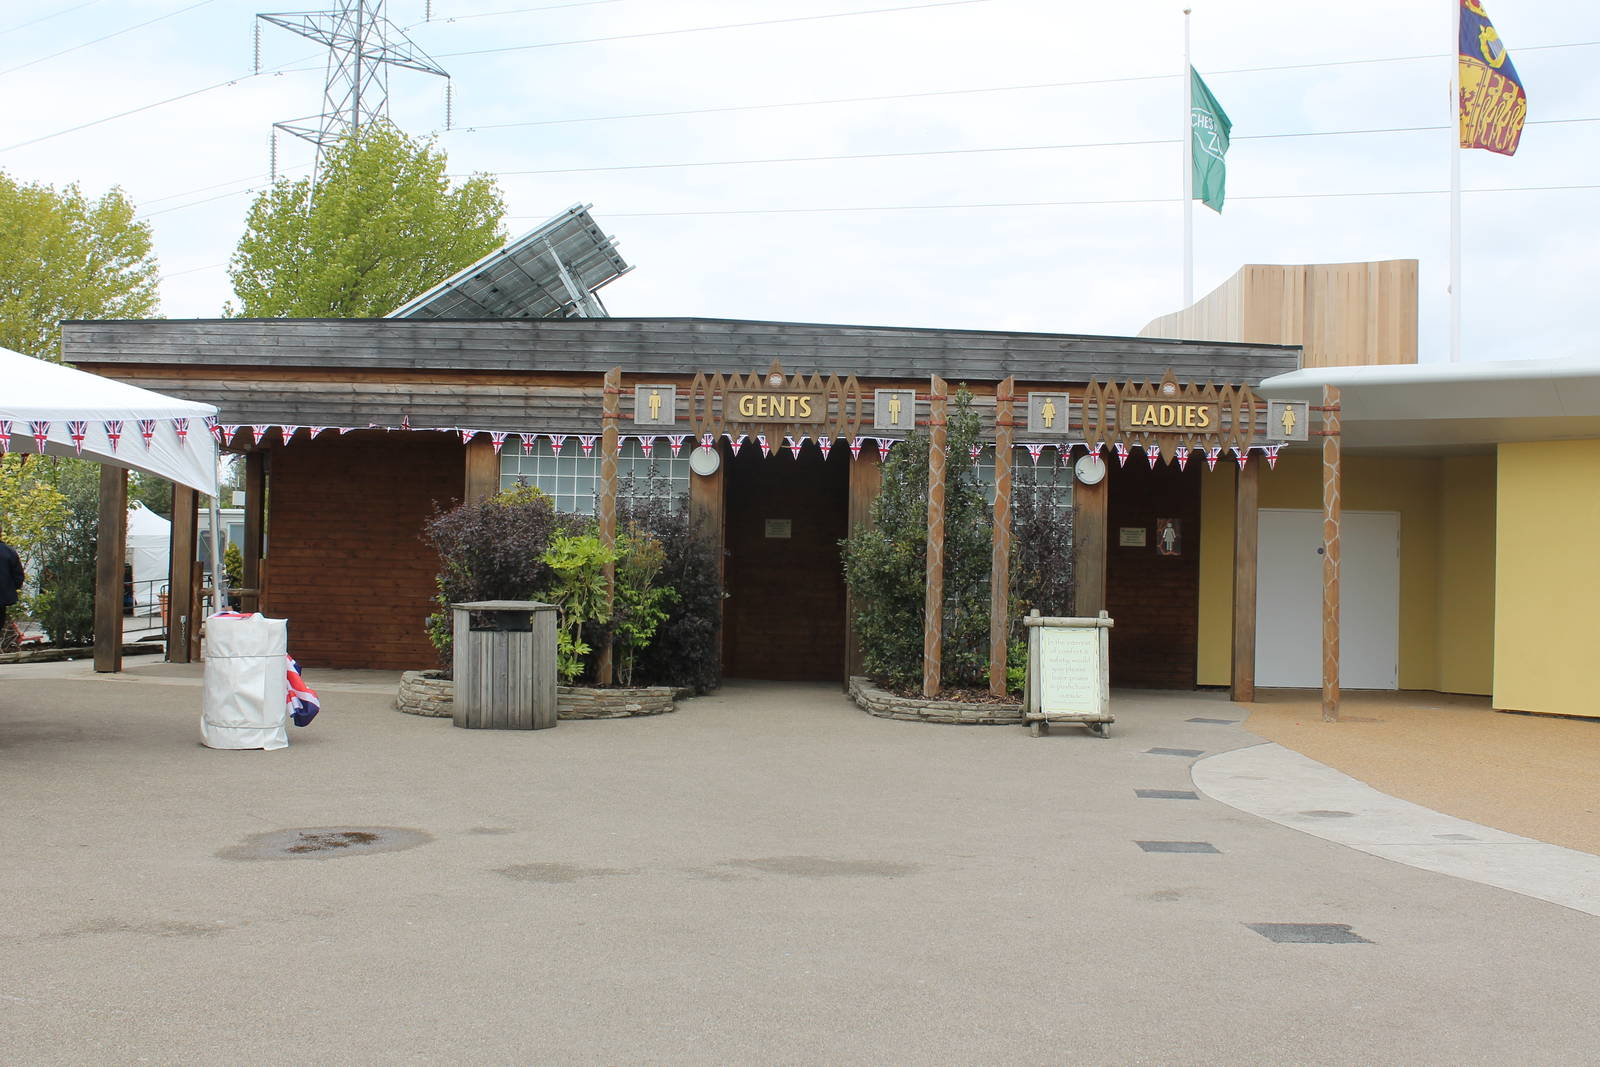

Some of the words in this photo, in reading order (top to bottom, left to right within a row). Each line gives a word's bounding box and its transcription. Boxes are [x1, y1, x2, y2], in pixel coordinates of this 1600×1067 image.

[1191, 113, 1215, 130] CHES
[739, 394, 812, 418] GENTS
[1131, 404, 1210, 428] LADIES
